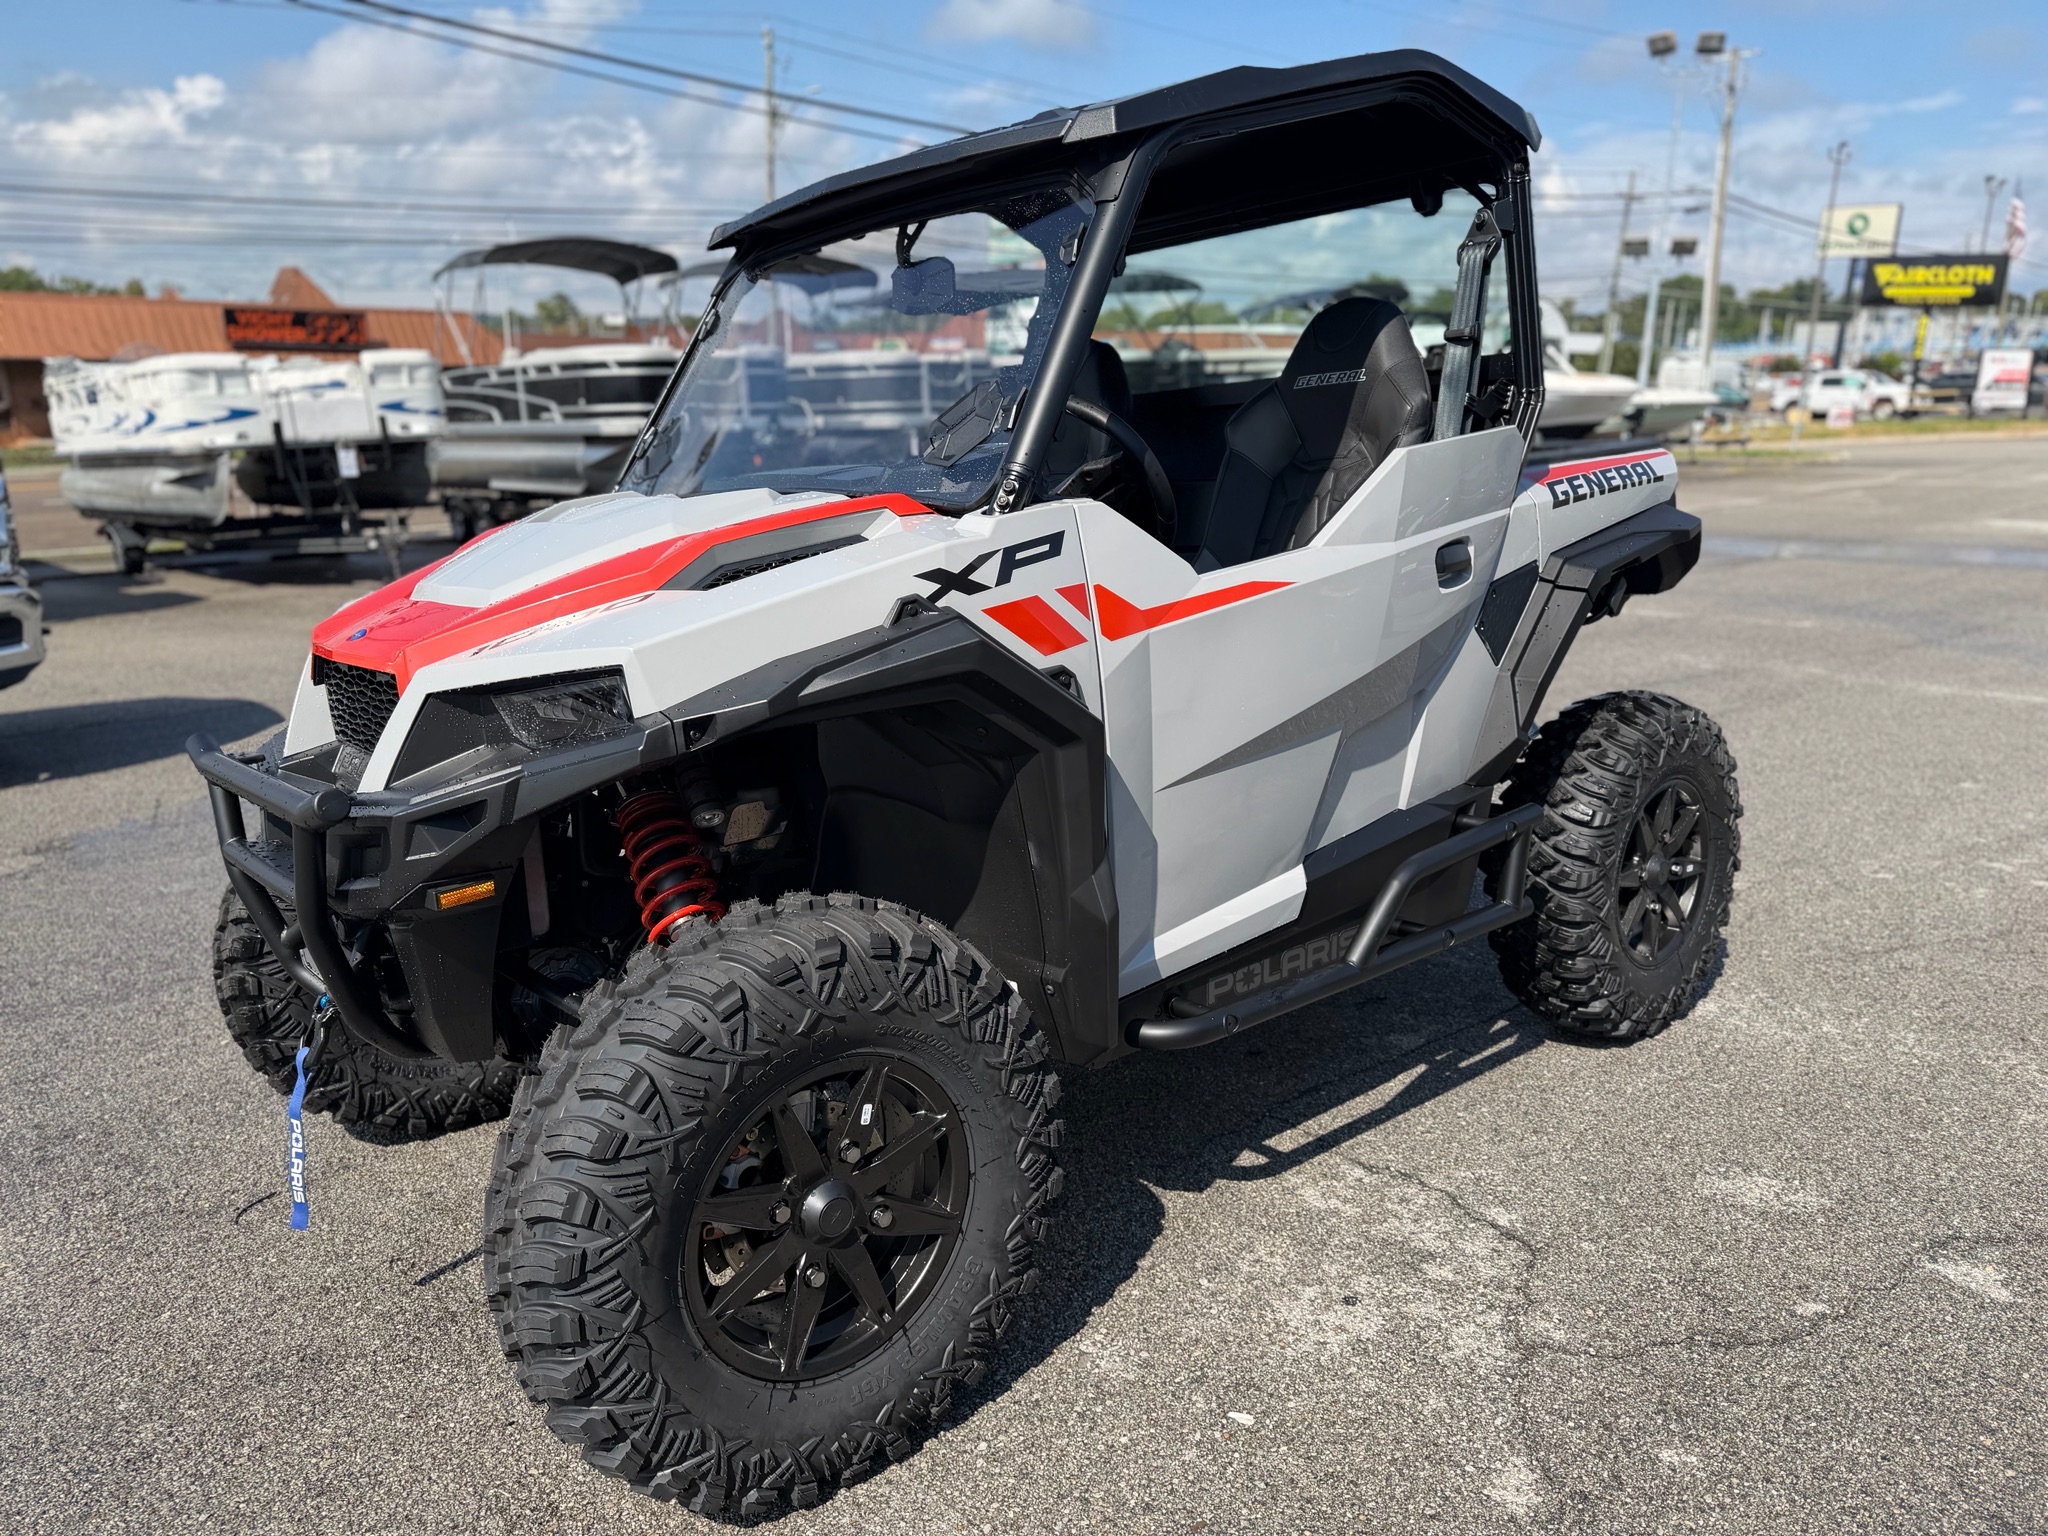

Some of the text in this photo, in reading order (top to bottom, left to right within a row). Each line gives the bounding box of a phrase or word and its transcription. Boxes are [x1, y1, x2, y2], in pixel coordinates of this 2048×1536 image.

[1293, 368, 1367, 390] GENERAL
[1546, 460, 1664, 509] GENERAL
[913, 529, 1066, 604] XP
[1206, 924, 1361, 1007] POLARIS
[290, 1118, 306, 1204] POLARIS
[895, 1255, 985, 1371] CRAWLER
